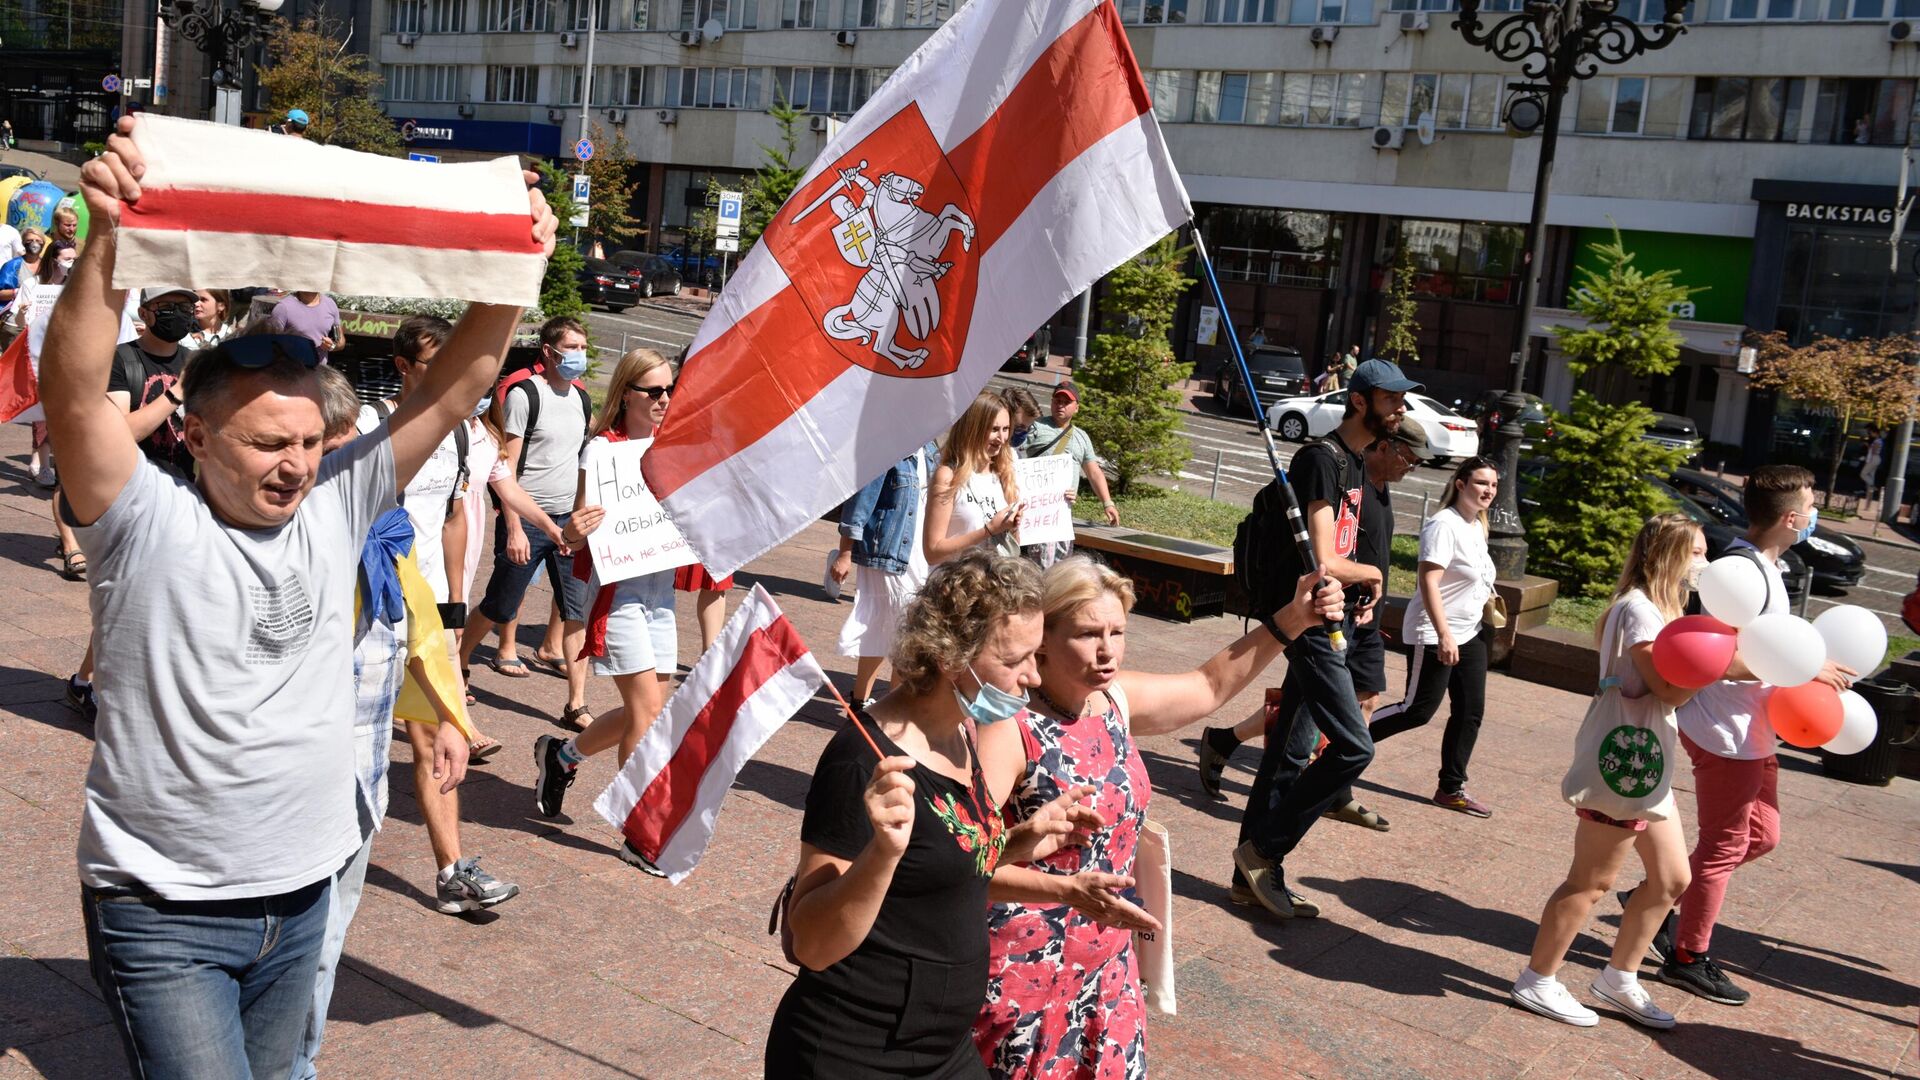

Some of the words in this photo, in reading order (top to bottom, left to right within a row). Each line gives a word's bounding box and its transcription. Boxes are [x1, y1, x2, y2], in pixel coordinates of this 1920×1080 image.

[1786, 203, 1894, 223] BACKSTAG
[598, 544, 634, 568] Нам
[640, 547, 657, 560] не
